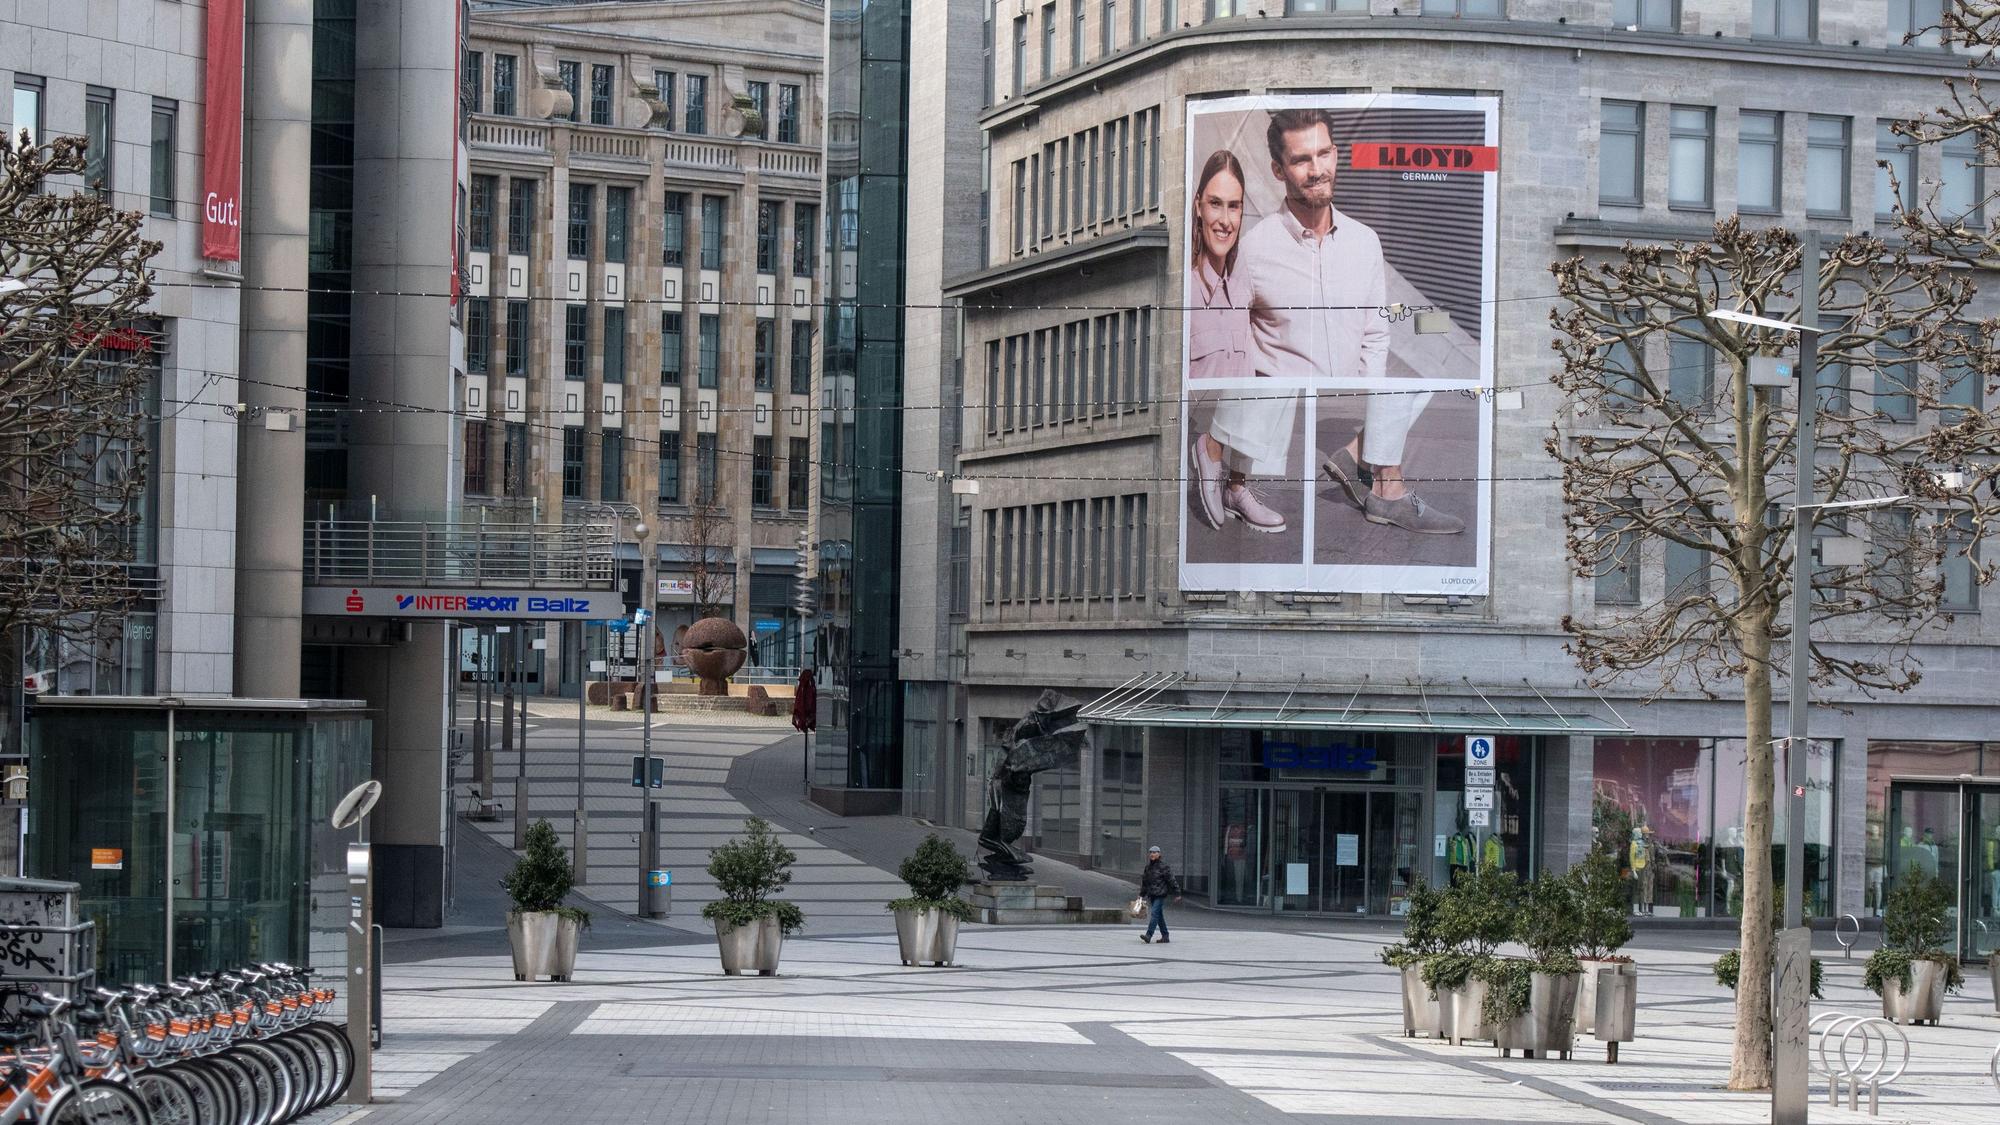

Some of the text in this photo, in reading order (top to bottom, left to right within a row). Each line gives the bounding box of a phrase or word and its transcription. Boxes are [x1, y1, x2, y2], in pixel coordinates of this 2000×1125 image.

[1379, 147, 1473, 168] LLOYD
[1401, 172, 1448, 181] GERMANY
[206, 192, 237, 226] Gut.
[416, 596, 519, 611] INTERSPORT
[528, 597, 590, 613] Baltz
[1263, 741, 1377, 770] Baltz
